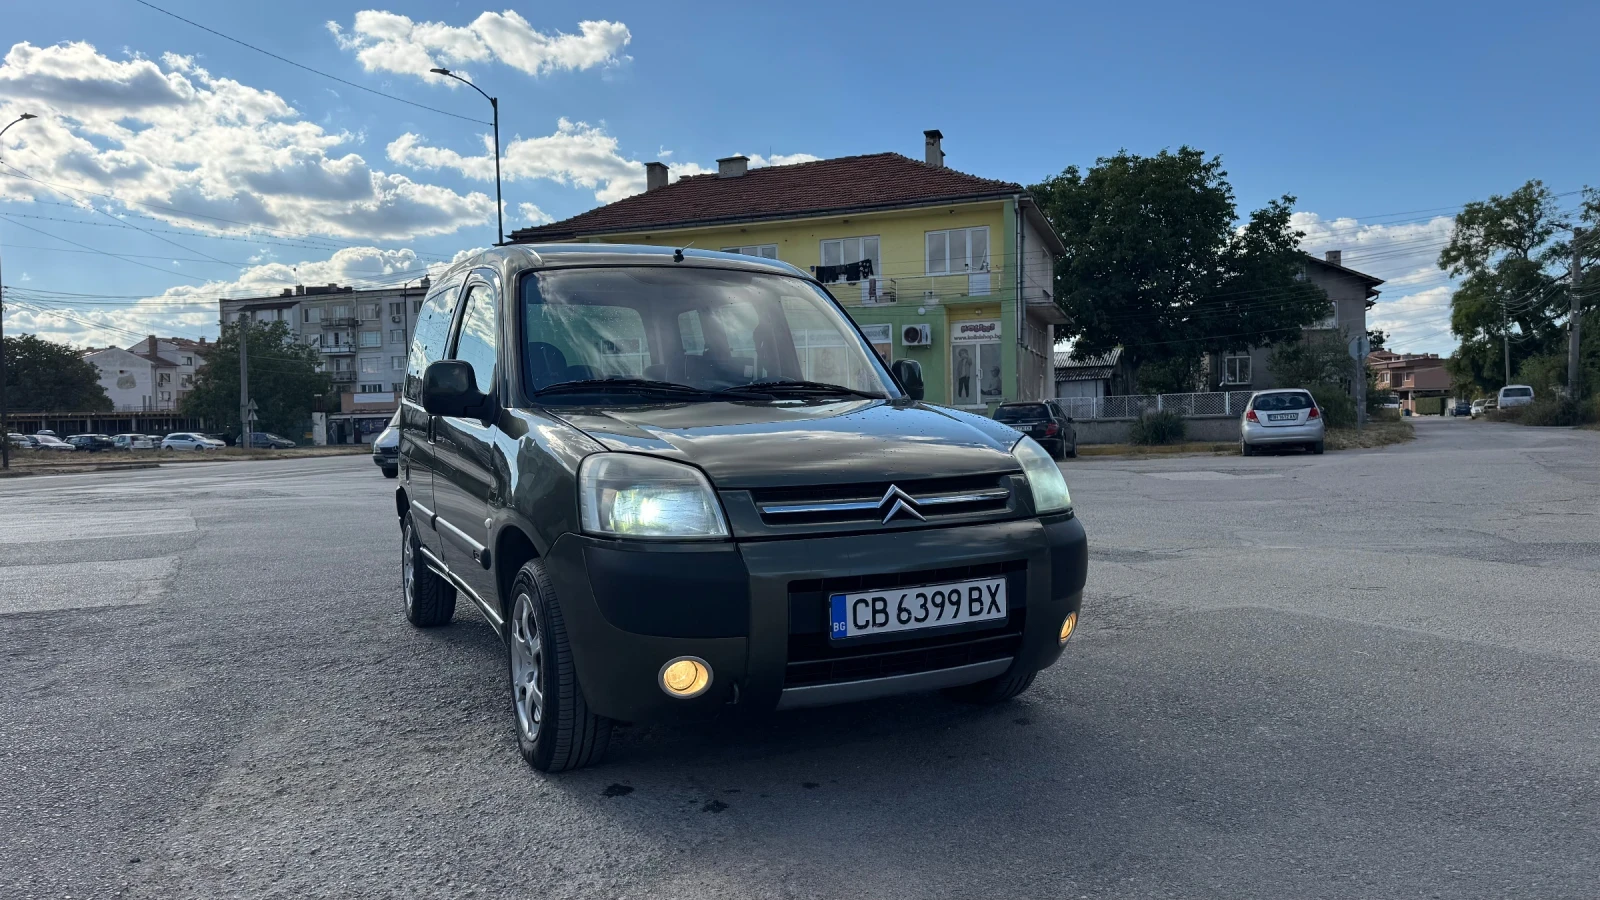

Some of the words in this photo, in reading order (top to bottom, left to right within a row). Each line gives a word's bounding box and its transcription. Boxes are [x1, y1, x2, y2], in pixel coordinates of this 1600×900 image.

[852, 596, 890, 630] CB
[896, 588, 962, 625] 6399
[968, 583, 1001, 617] BX
[833, 622, 846, 632] BG
